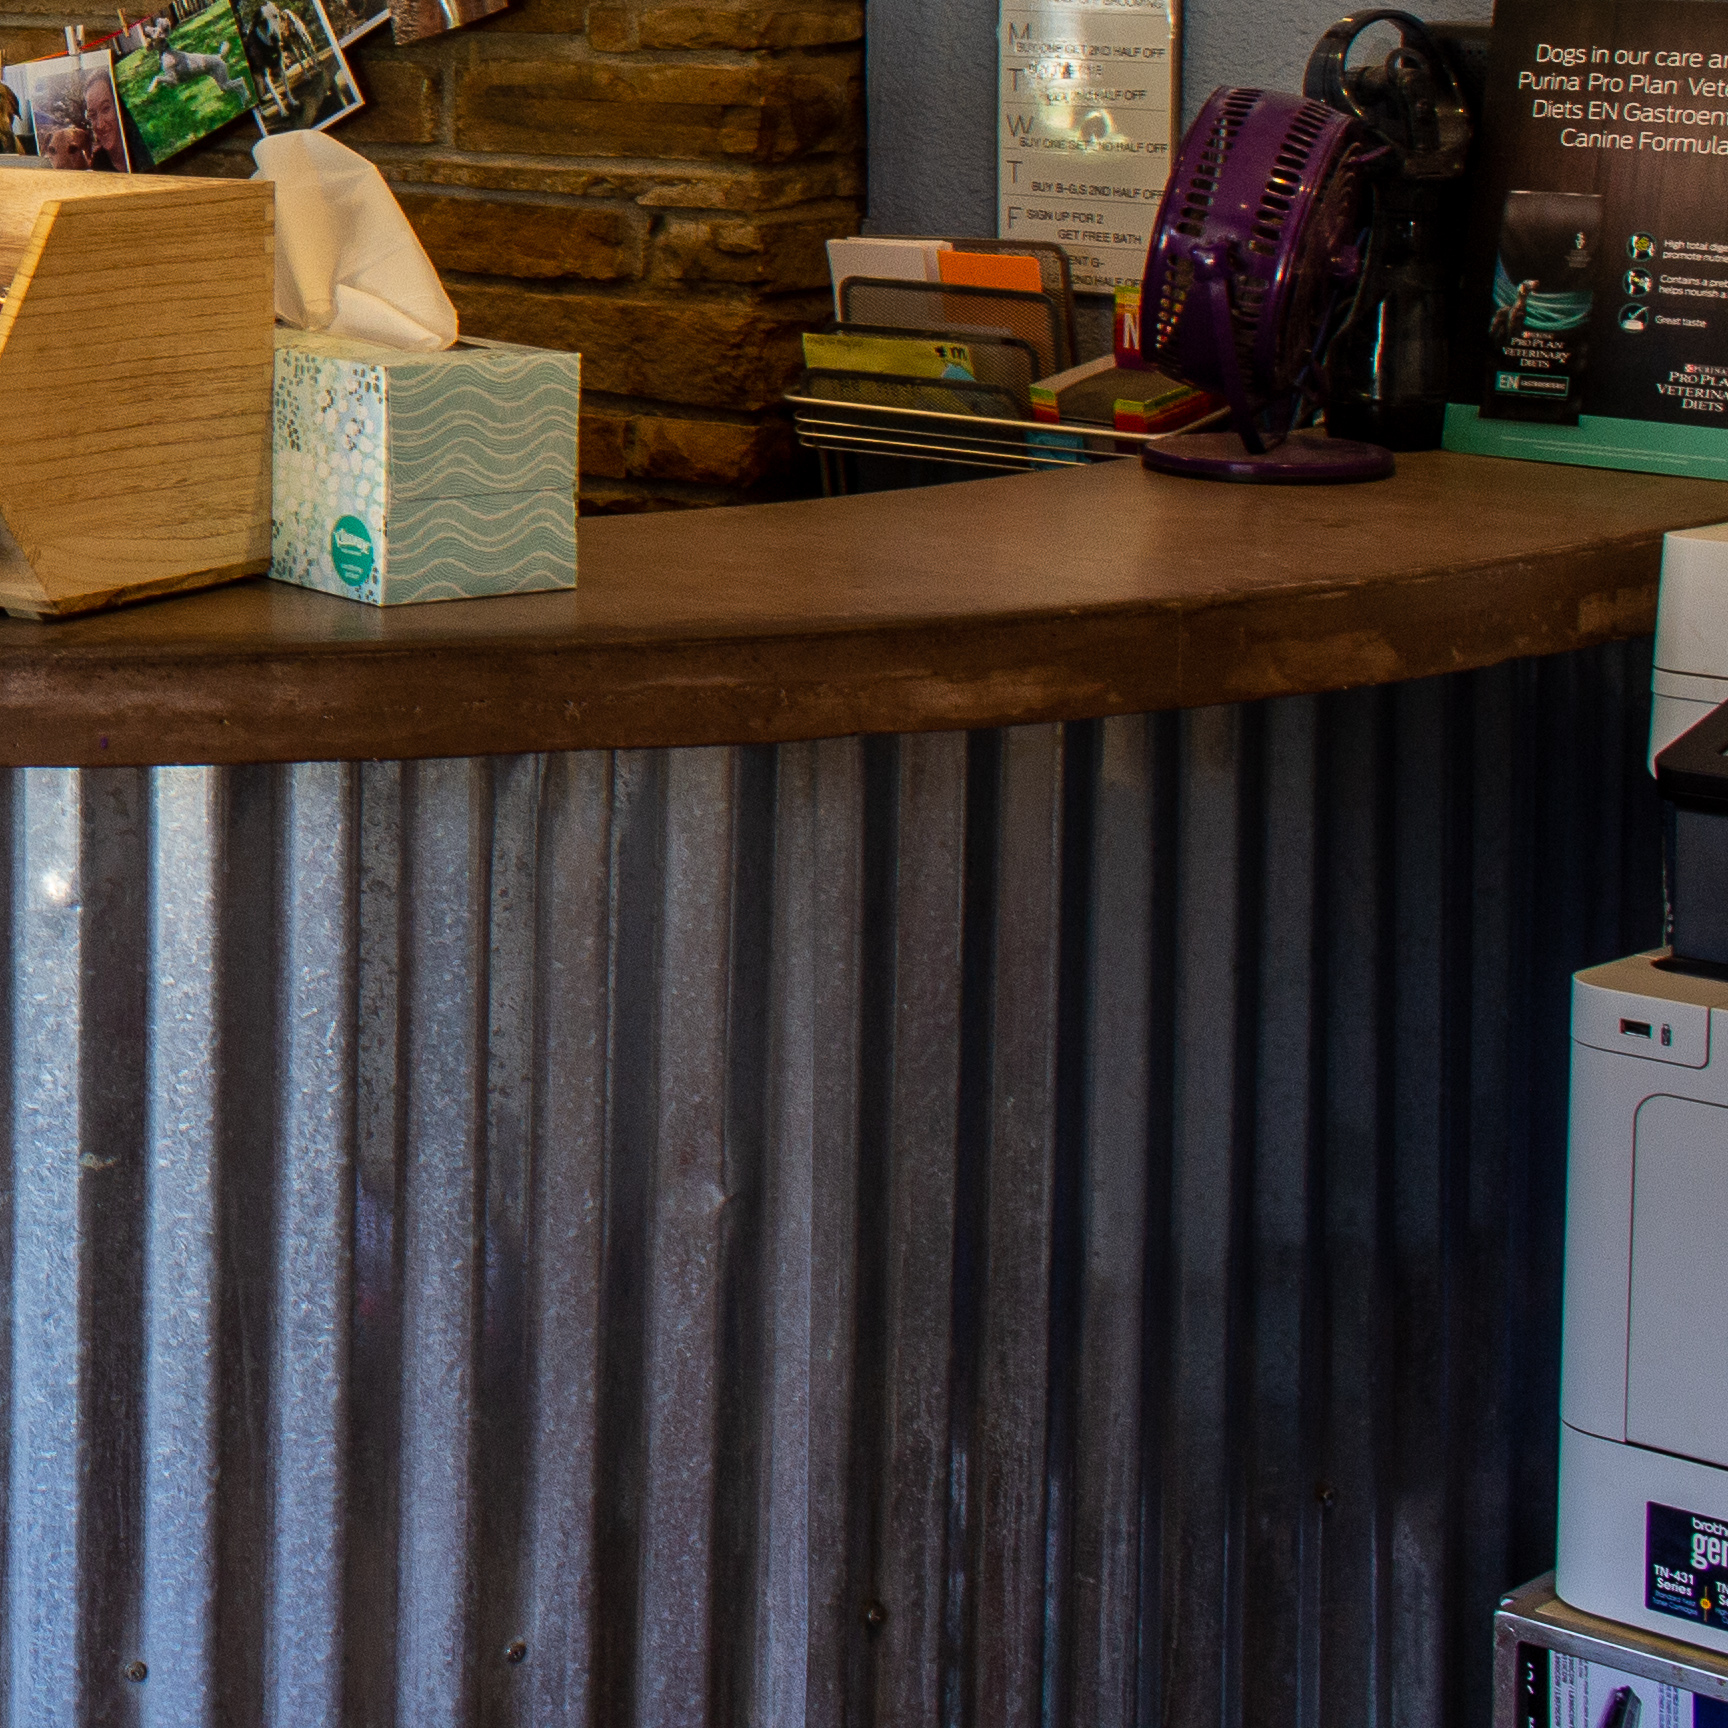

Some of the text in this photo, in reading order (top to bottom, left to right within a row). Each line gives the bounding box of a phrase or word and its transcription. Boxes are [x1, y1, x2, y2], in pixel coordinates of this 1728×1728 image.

[1536, 43, 1703, 67] Dogs in our care
[1518, 71, 1678, 95] Purina Pro Plan
[1533, 99, 1728, 125] Diets EN Gastroen
[1561, 128, 1634, 150] Canine
[1113, 187, 1141, 198] HALF
[1007, 206, 1104, 229] F SIGN UP FOR 2
[1058, 229, 1142, 244] GET FREE BATH
[1655, 315, 1707, 328] Great taste
[1681, 398, 1724, 412] DIETS
[1653, 1564, 1694, 1585] TN-431
[1657, 1577, 1692, 1596] Series
